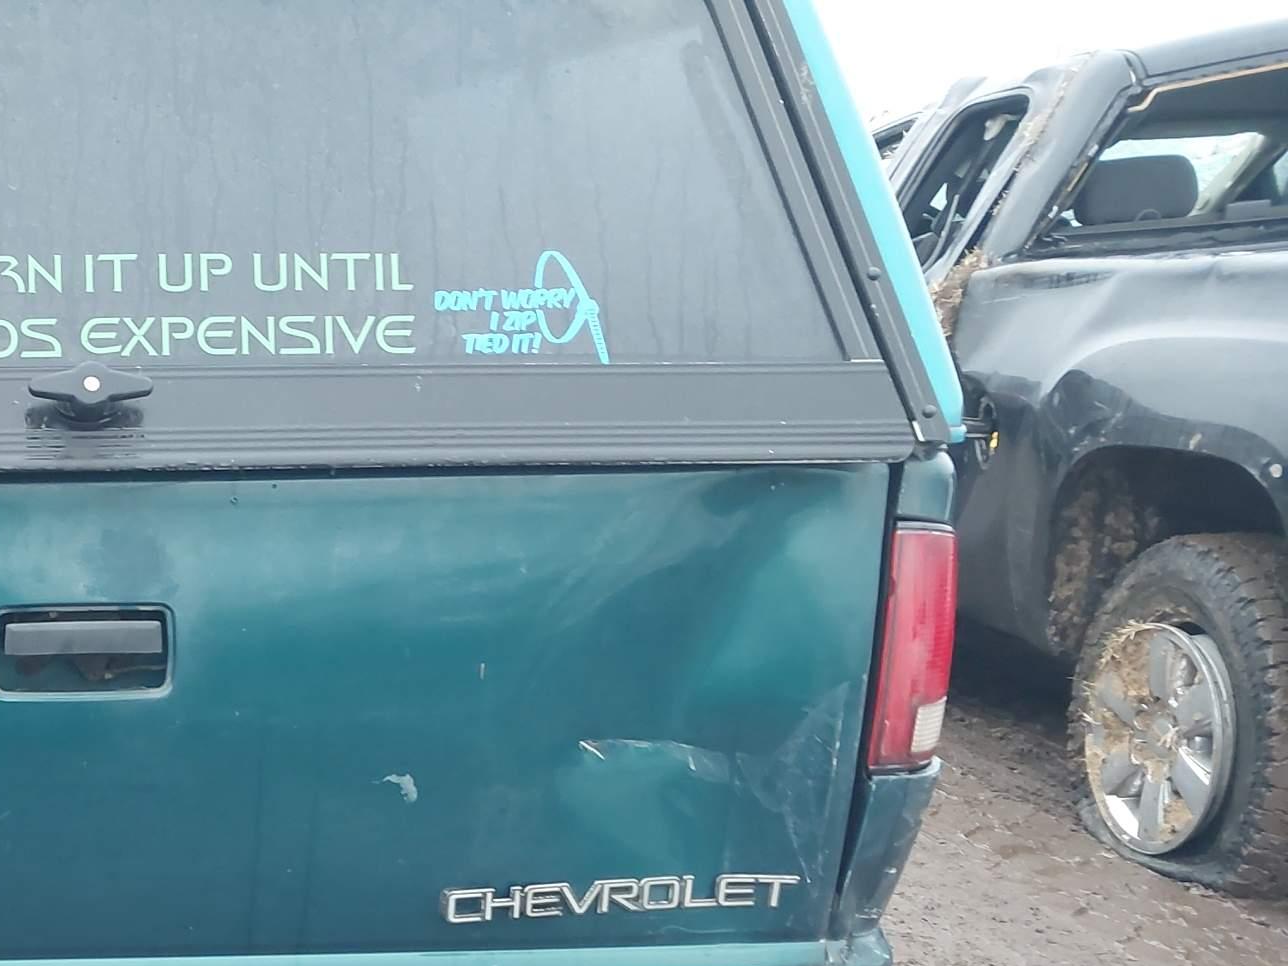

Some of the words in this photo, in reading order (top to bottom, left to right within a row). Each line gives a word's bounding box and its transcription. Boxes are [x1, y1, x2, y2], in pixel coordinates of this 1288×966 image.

[84, 253, 139, 293] IT
[158, 253, 233, 293] UP
[252, 252, 415, 292] UNTIL
[434, 288, 499, 311] DON'T
[500, 287, 576, 310] WORRY
[80, 314, 417, 357] EXPENSIVE
[502, 310, 536, 331] ZIP
[511, 331, 543, 354] IT!
[442, 873, 802, 923] CHEVROLET
